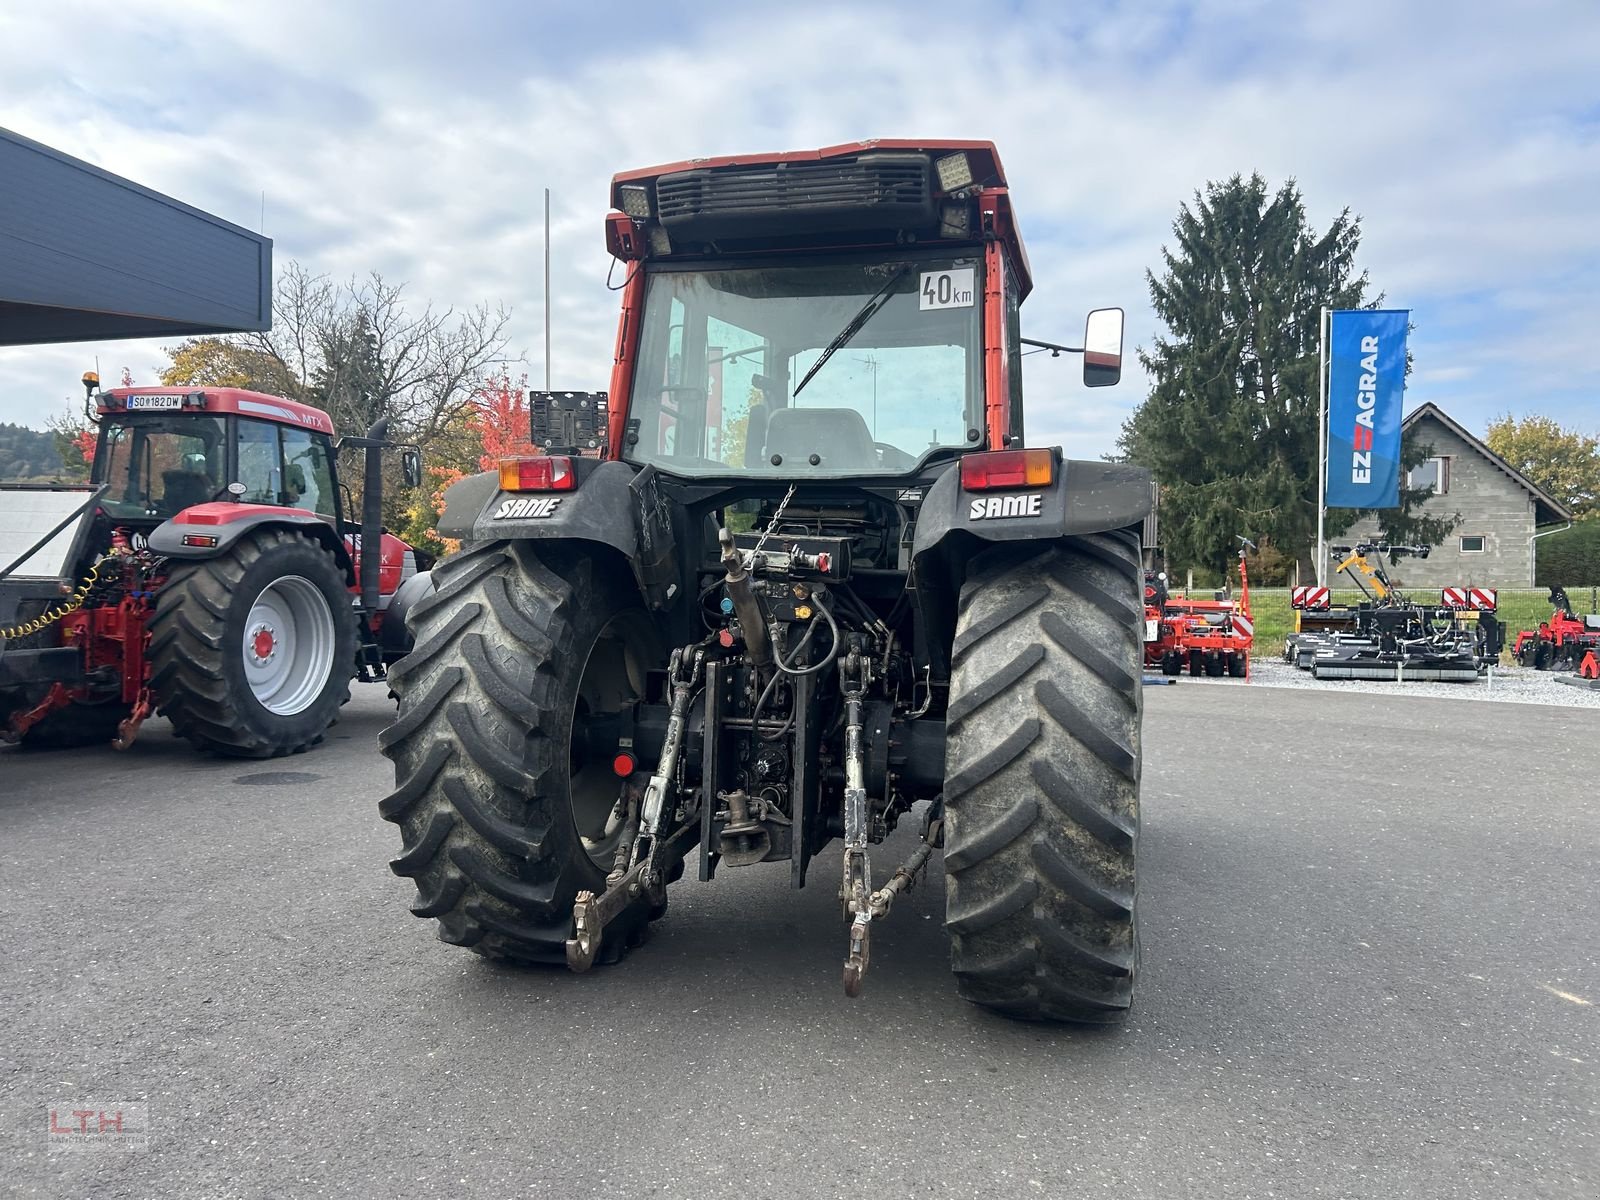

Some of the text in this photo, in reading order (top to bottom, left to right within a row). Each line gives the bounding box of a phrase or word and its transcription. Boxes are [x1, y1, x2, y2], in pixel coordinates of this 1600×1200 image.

[923, 274, 972, 305] 40 km
[1355, 335, 1379, 429] AGRAR
[302, 413, 324, 429] MTX
[493, 498, 561, 519] SAME
[969, 494, 1041, 520] SAME
